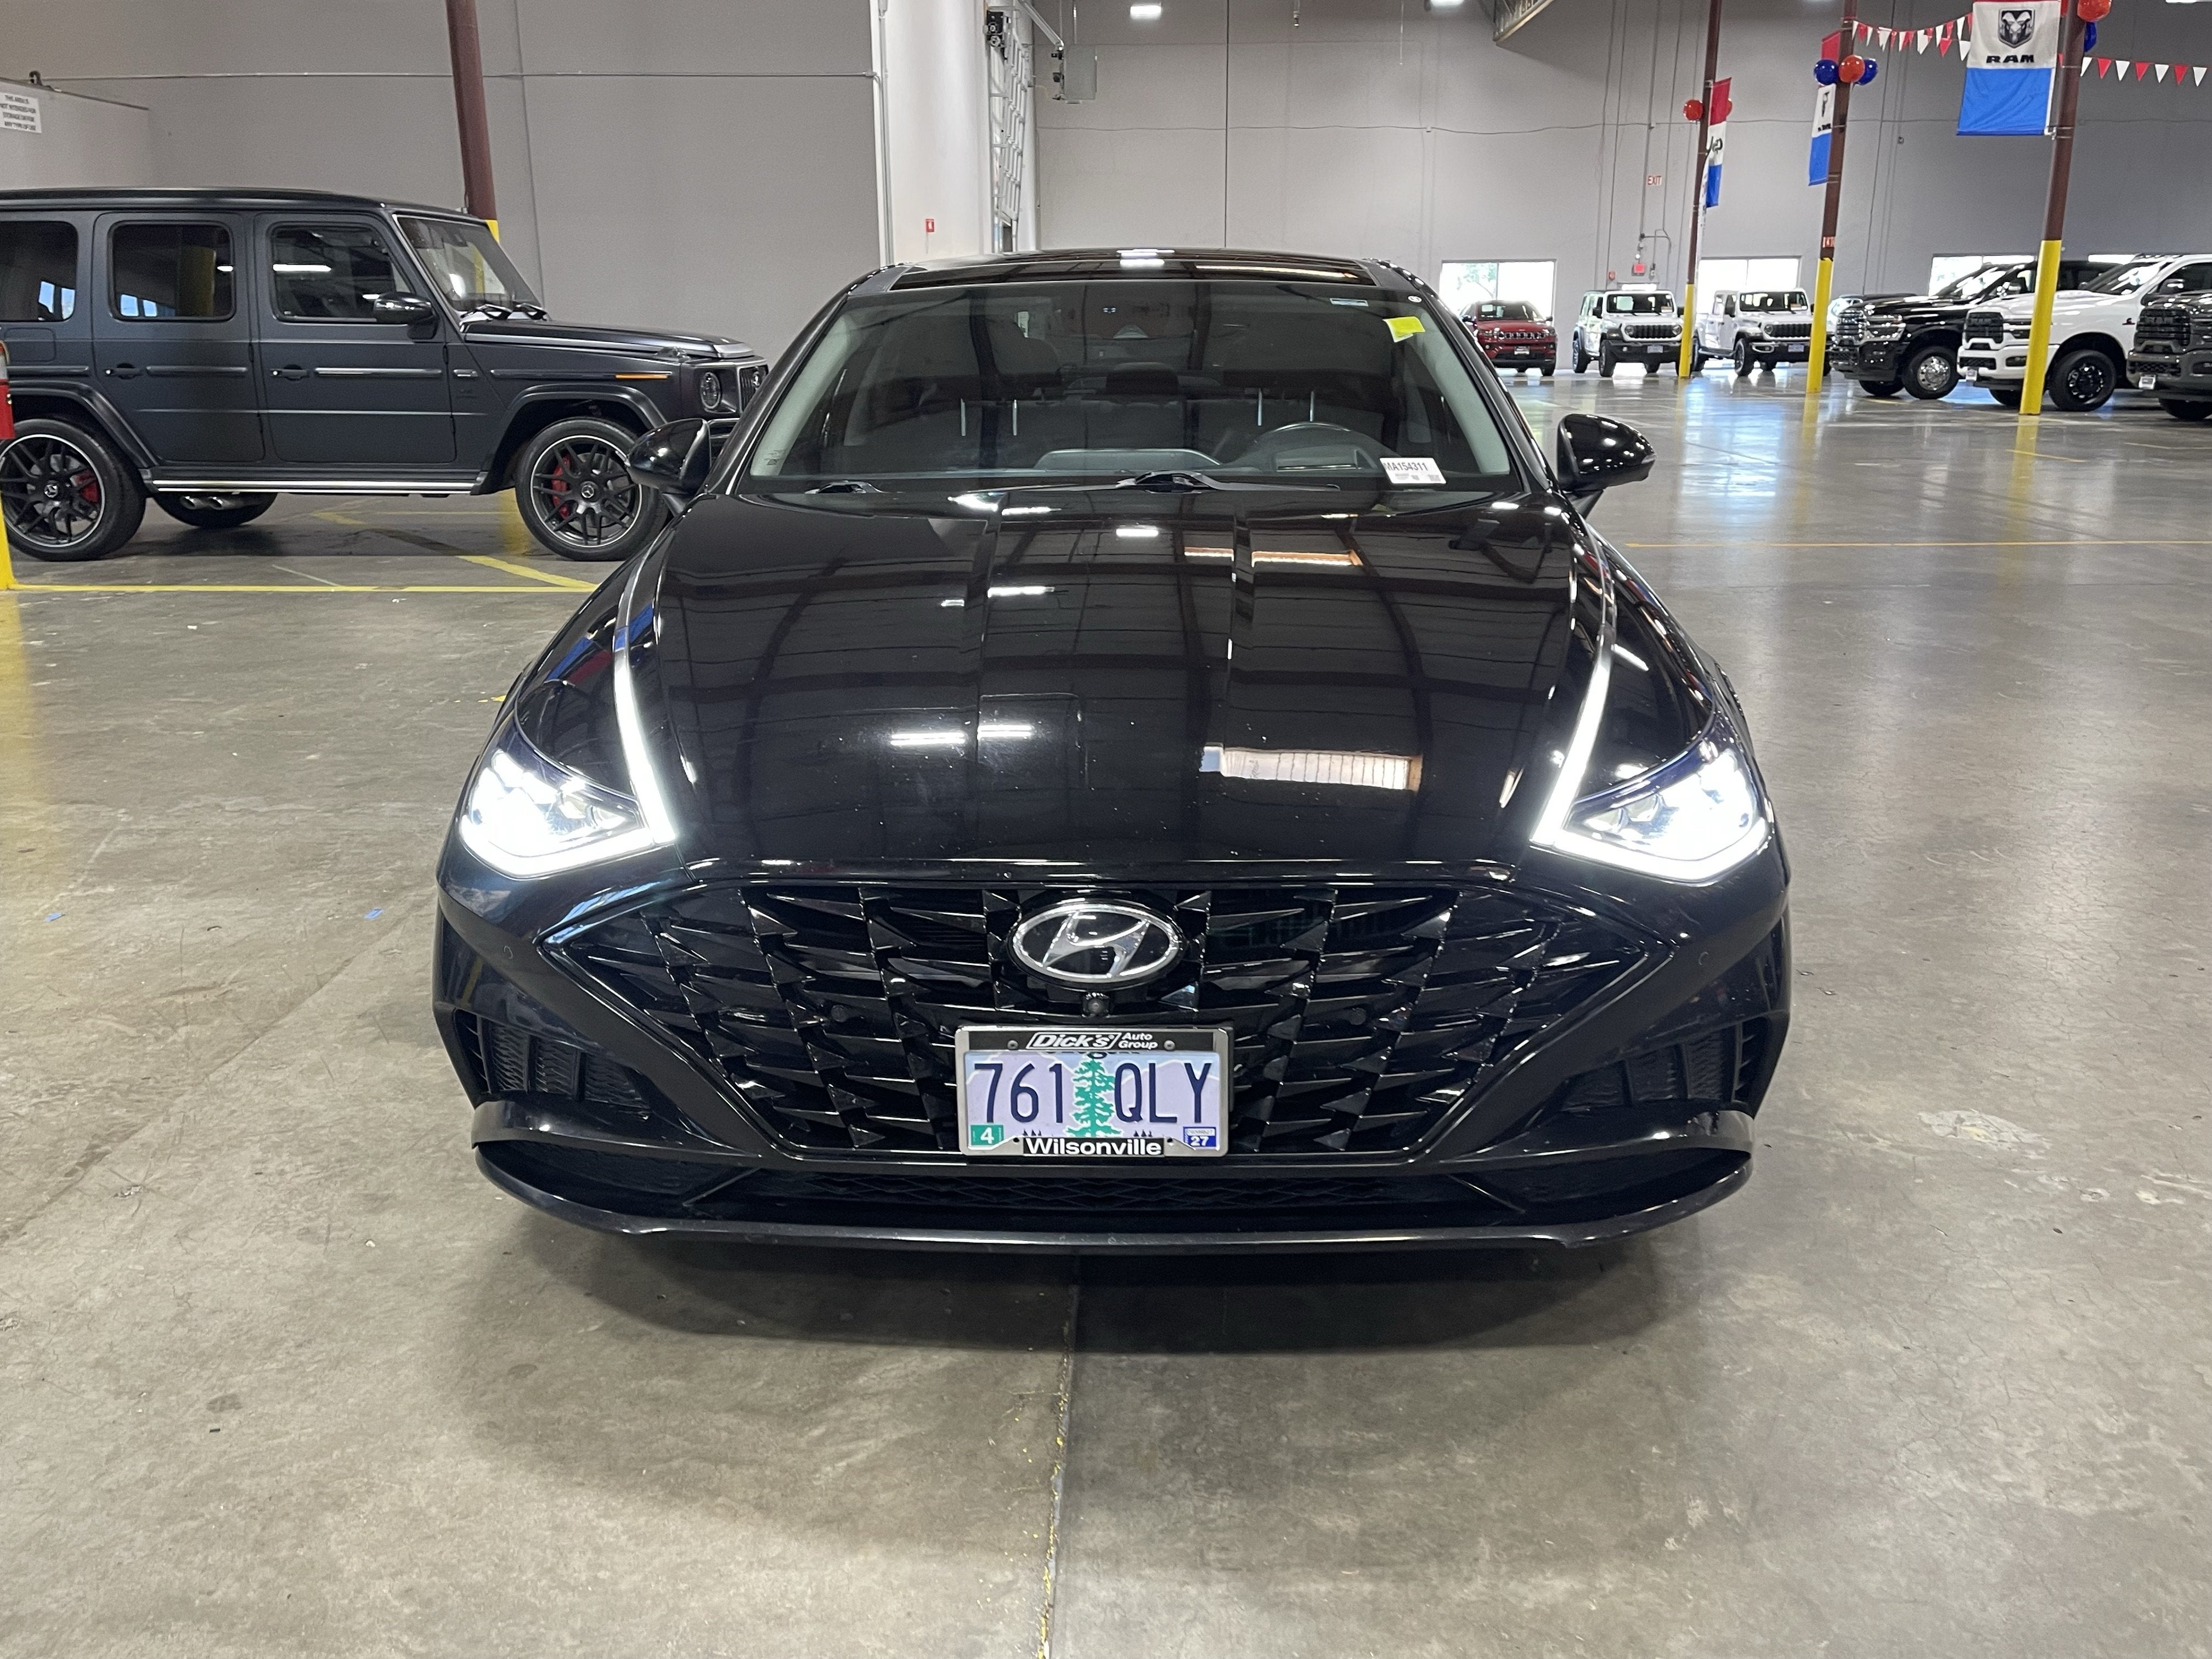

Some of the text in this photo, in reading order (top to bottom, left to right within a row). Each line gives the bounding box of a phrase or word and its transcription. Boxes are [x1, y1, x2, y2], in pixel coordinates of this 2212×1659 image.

[1986, 55, 2034, 63] RAM
[1647, 176, 1662, 185] EXIT
[1032, 1034, 1110, 1047] Dick's
[1122, 1032, 1153, 1041] Auto
[1118, 1041, 1158, 1049] Group
[974, 1063, 1211, 1123] 761 QLY
[980, 1127, 995, 1144] 4
[1190, 1136, 1209, 1146] 27
[1025, 1138, 1161, 1155] Wilsonville
